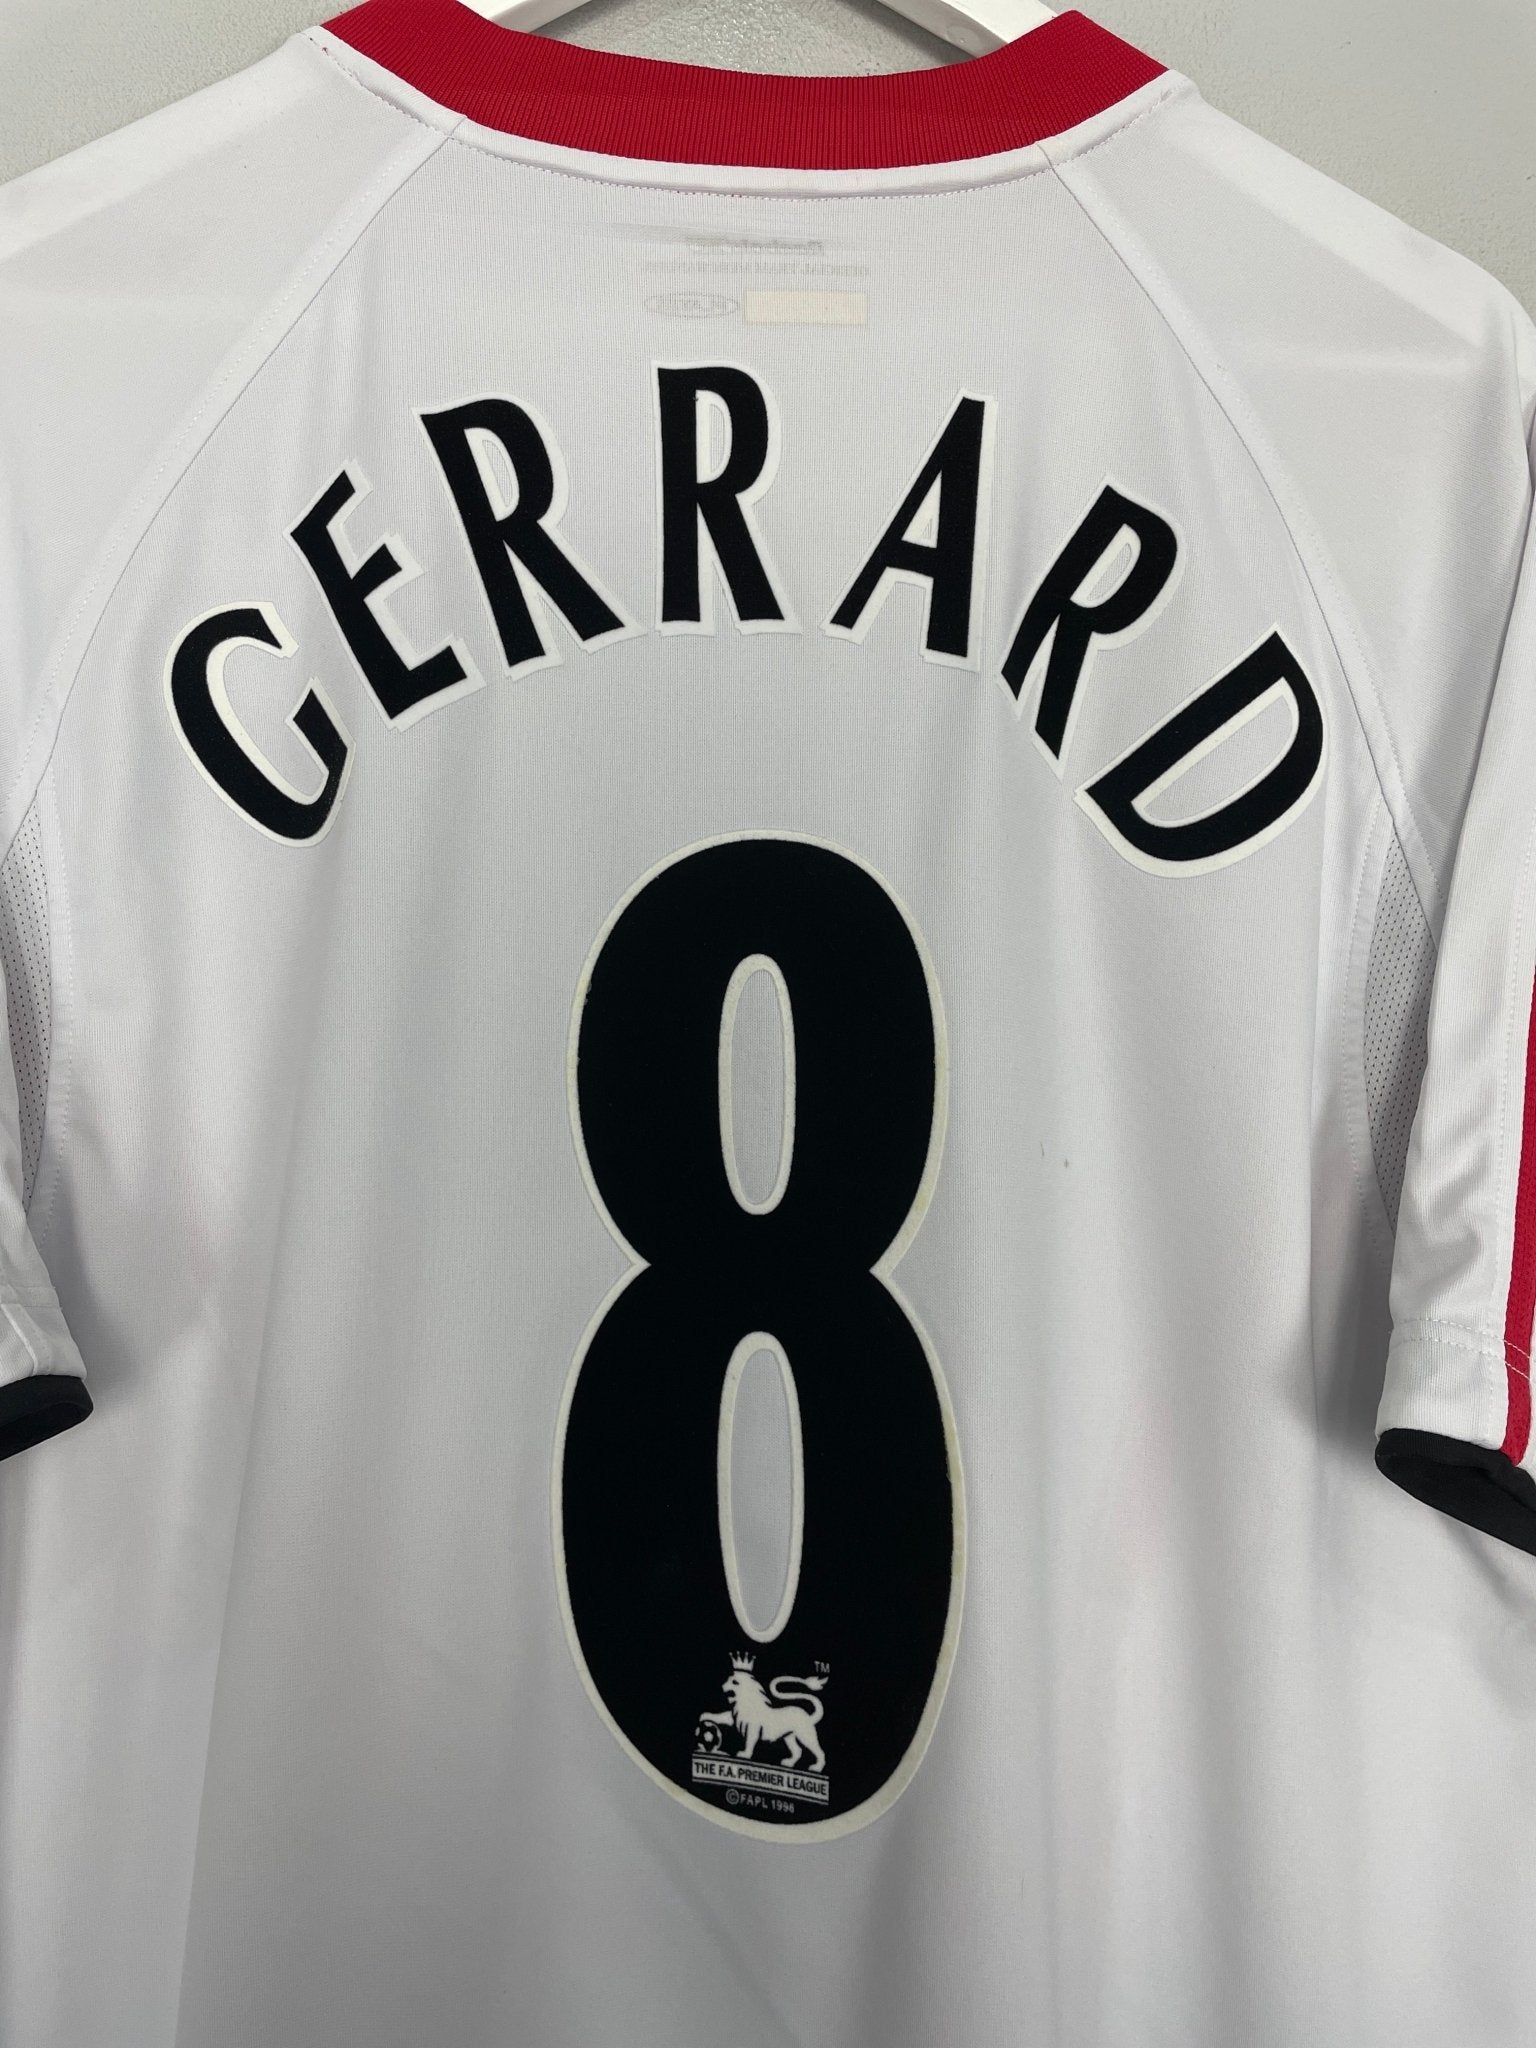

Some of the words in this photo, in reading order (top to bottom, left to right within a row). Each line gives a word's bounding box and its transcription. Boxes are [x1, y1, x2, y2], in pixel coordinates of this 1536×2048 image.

[166, 362, 1326, 874] GERRARD
[555, 831, 964, 1838] 8
[814, 1660, 831, 1673] TM
[693, 1761, 716, 1775] THE
[718, 1763, 736, 1779] F.A.
[737, 1767, 785, 1787] PREMIER
[786, 1775, 827, 1795] LEAGUE
[771, 1799, 795, 1814] 1996
